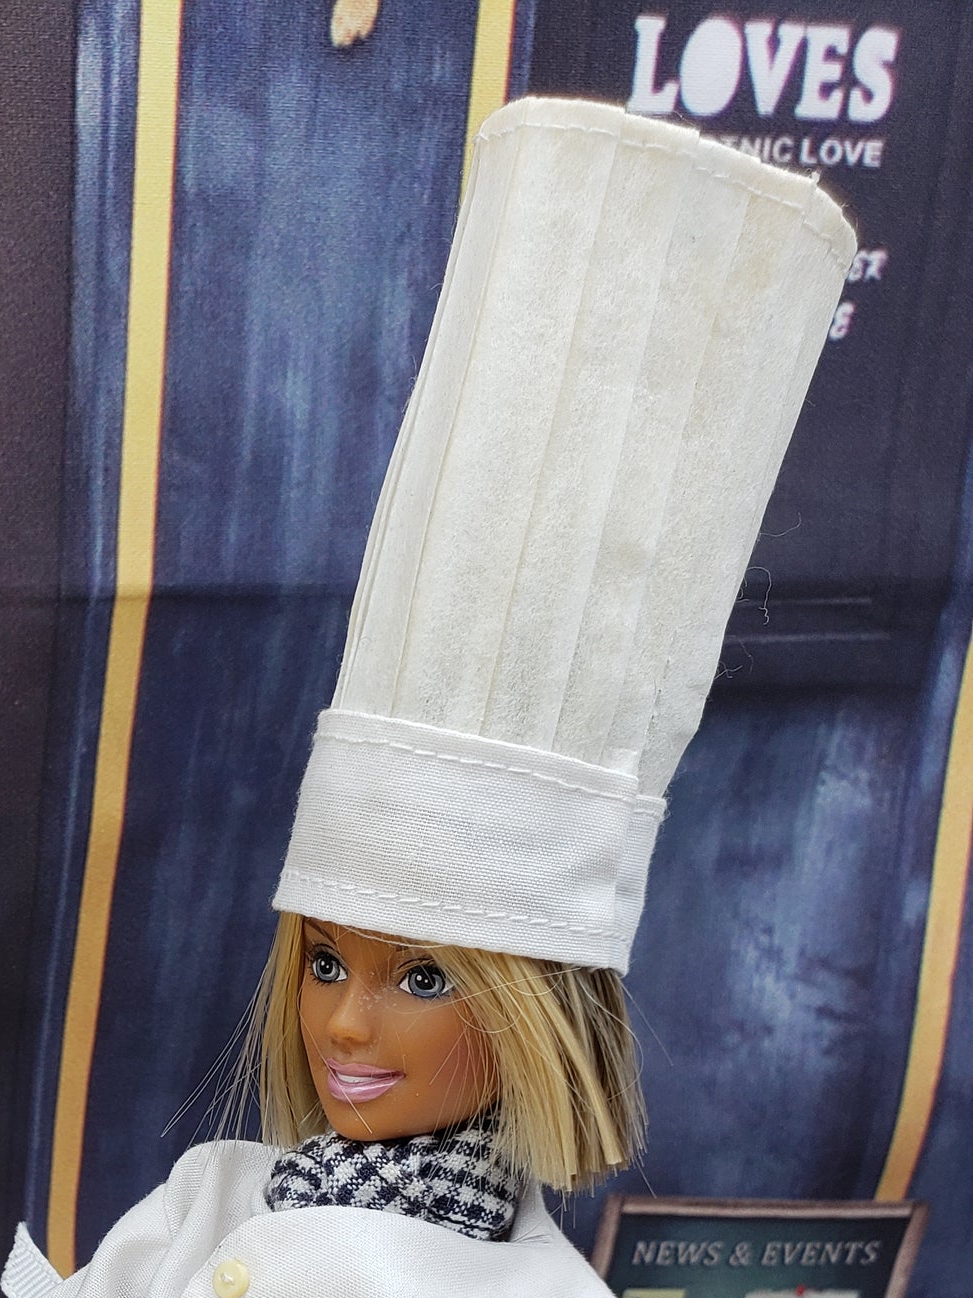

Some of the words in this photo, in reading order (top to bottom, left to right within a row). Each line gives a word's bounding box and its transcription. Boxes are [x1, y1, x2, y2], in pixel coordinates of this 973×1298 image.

[627, 15, 900, 123] LOVES
[800, 137, 884, 168] LOVE
[632, 1241, 724, 1266] NEWS
[729, 1240, 753, 1266] &
[762, 1240, 881, 1267] EVENTS
